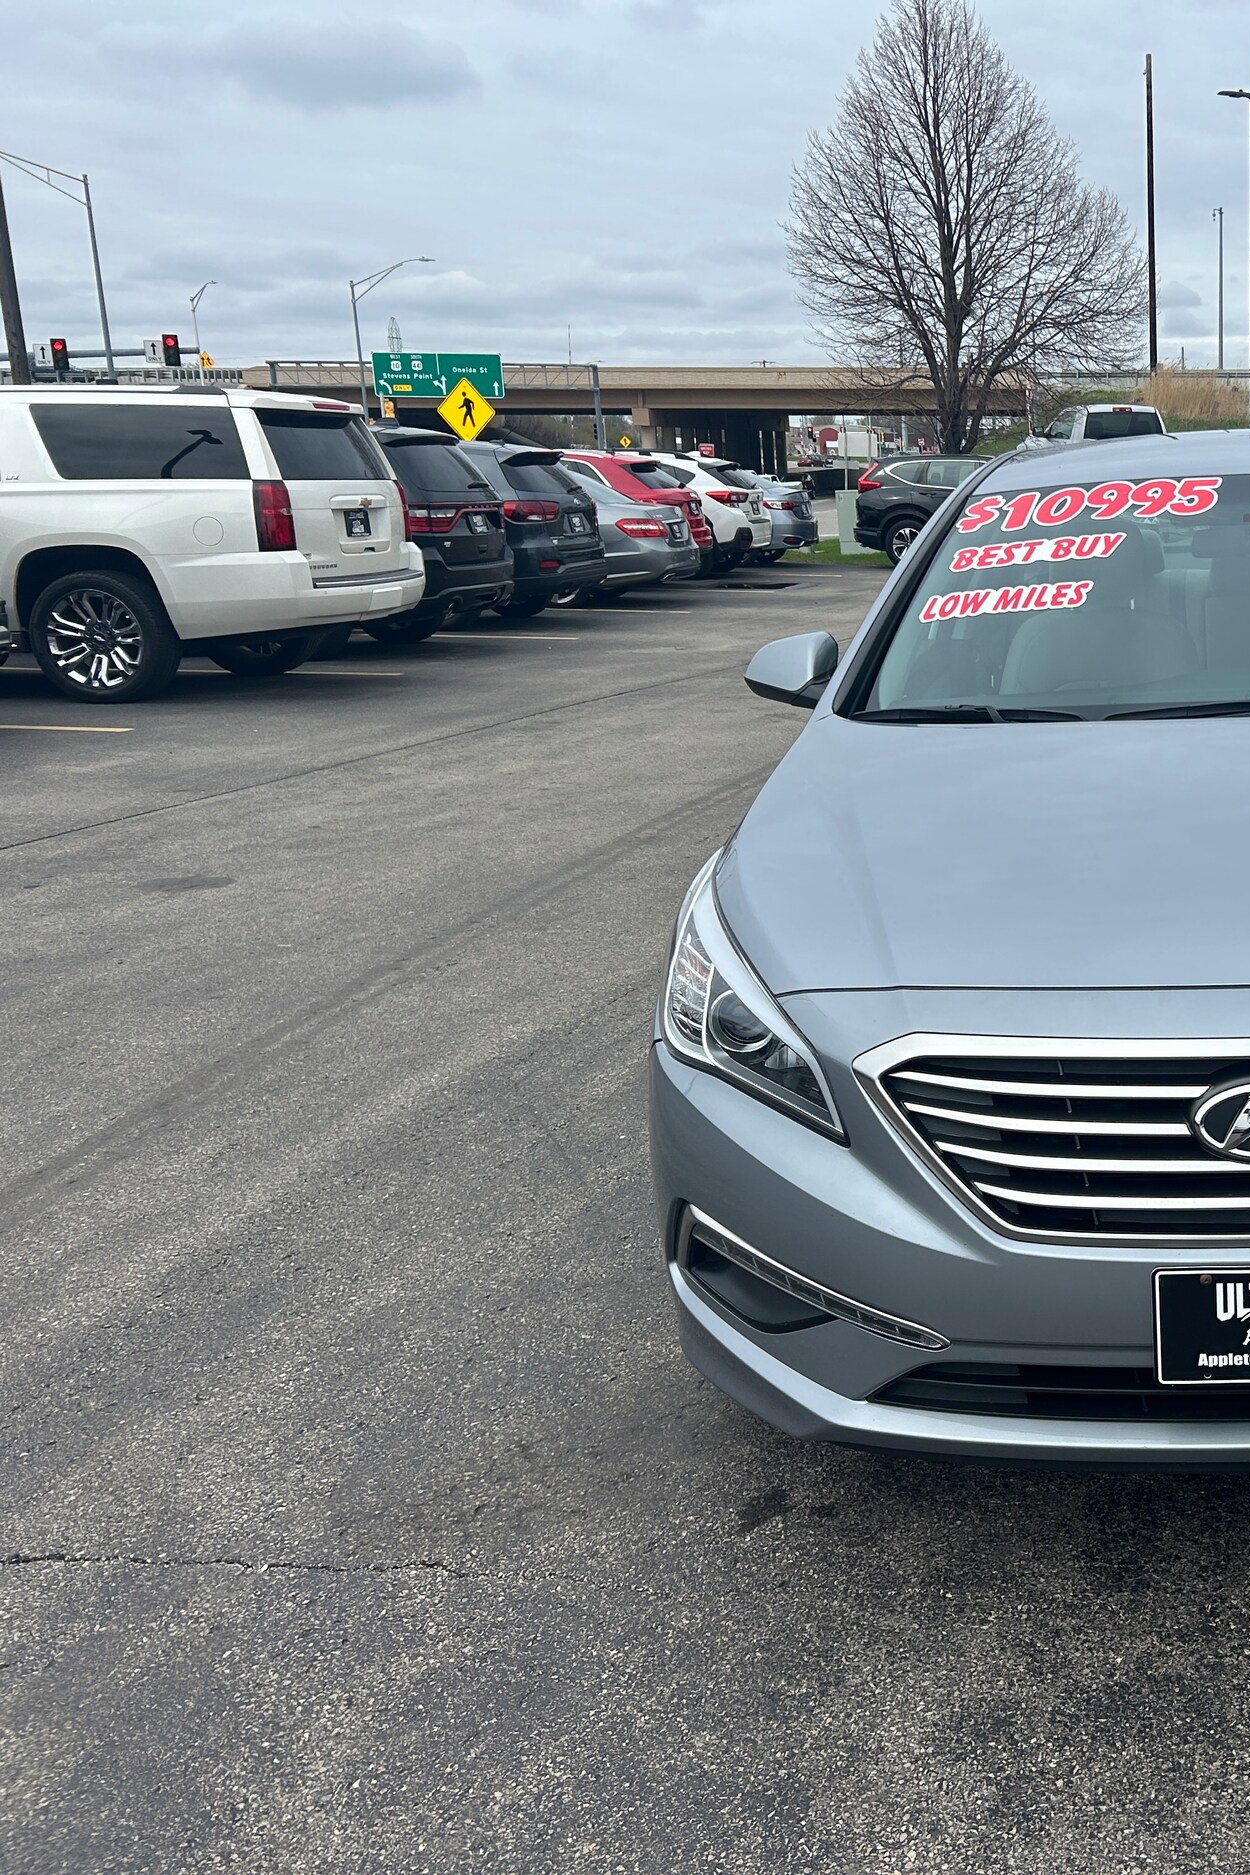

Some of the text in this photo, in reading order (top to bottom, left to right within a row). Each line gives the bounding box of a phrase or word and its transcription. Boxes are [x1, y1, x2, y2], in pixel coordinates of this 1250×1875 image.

[956, 477, 1223, 533] $10995
[951, 533, 1125, 572] BEST BUY
[921, 580, 1093, 622] LOW MILES
